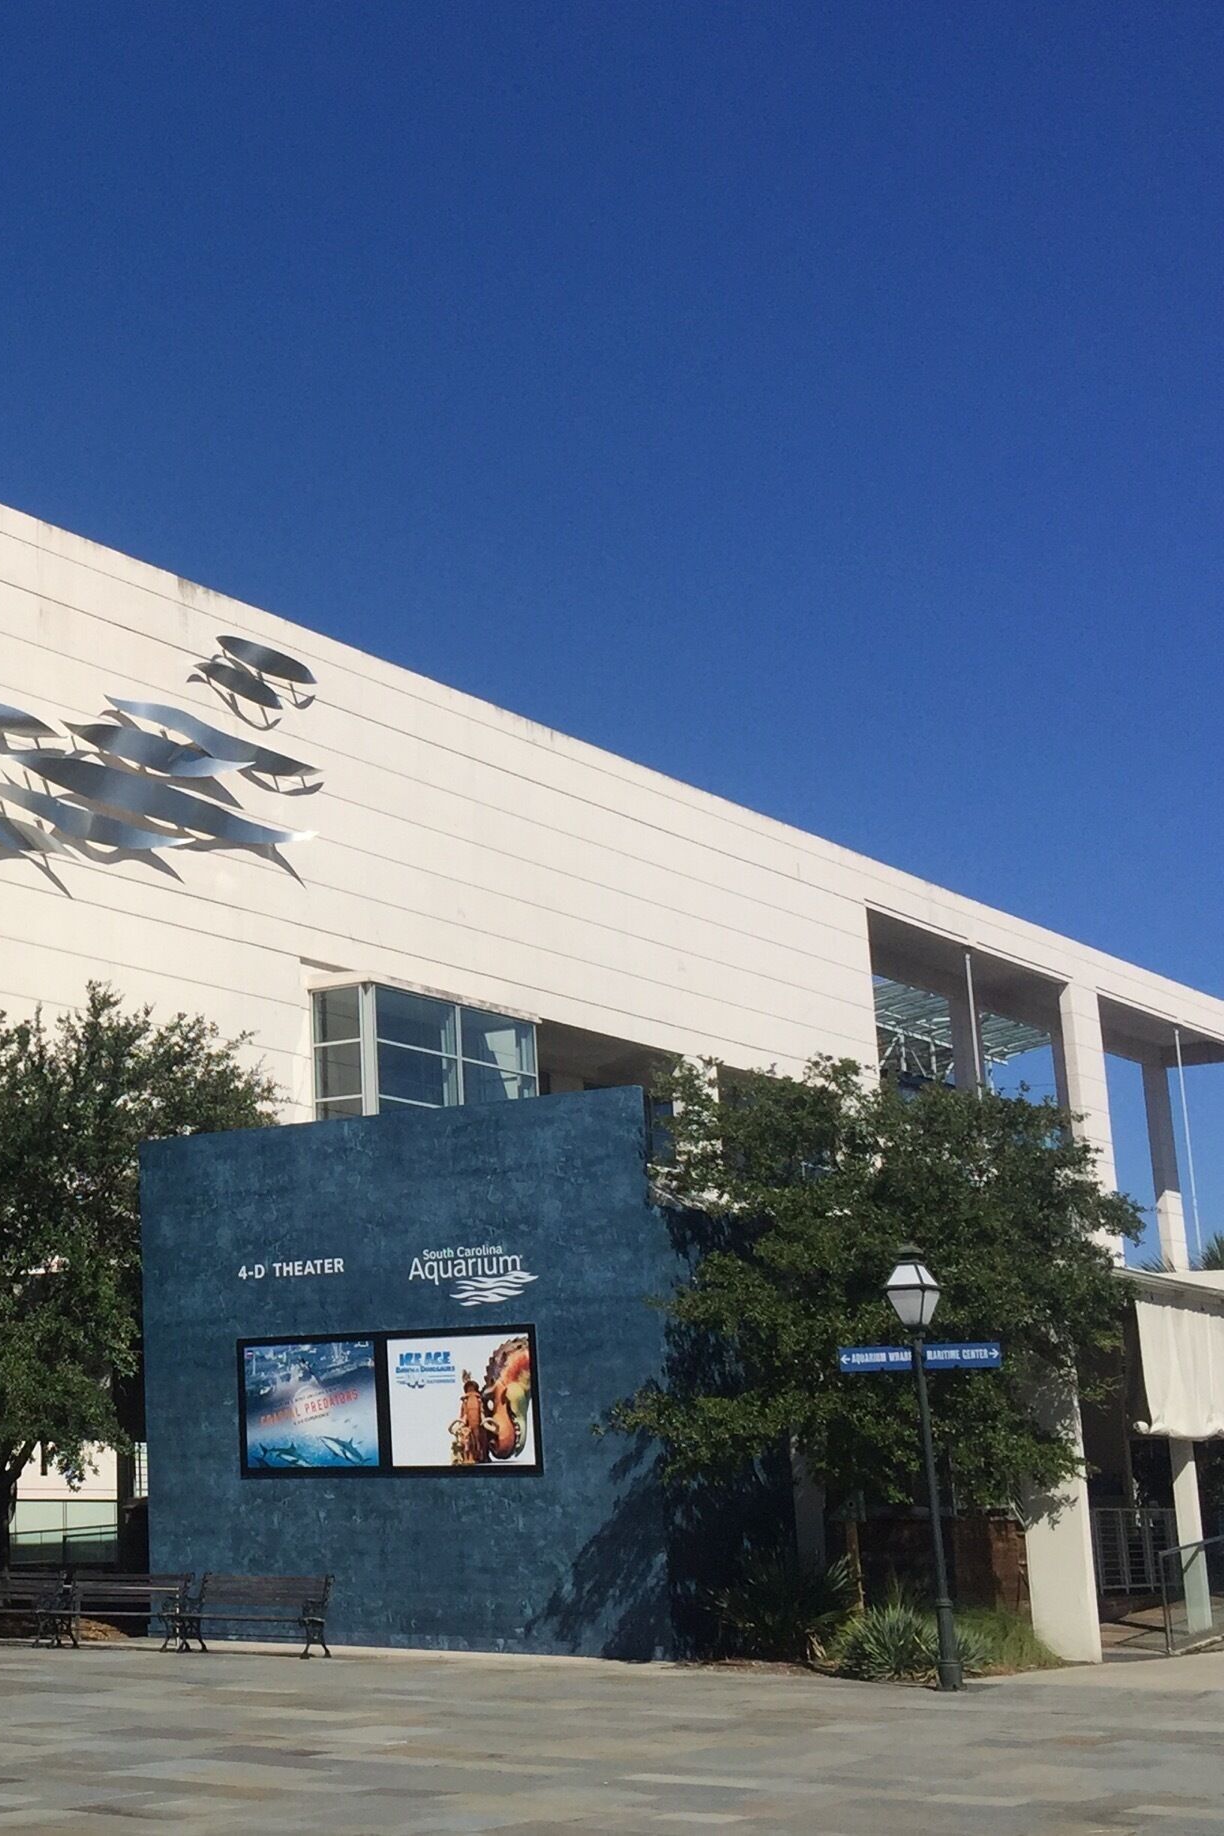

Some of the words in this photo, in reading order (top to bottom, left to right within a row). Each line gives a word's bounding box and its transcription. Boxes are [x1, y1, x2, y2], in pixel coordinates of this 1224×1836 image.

[422, 1247, 454, 1260] South
[457, 1244, 504, 1257] Carolina
[238, 1265, 265, 1280] 4-D
[272, 1258, 344, 1277] THEATER
[408, 1254, 521, 1285] Aquarium
[962, 1348, 988, 1360] CENTER
[304, 1388, 360, 1414] PREDATORS
